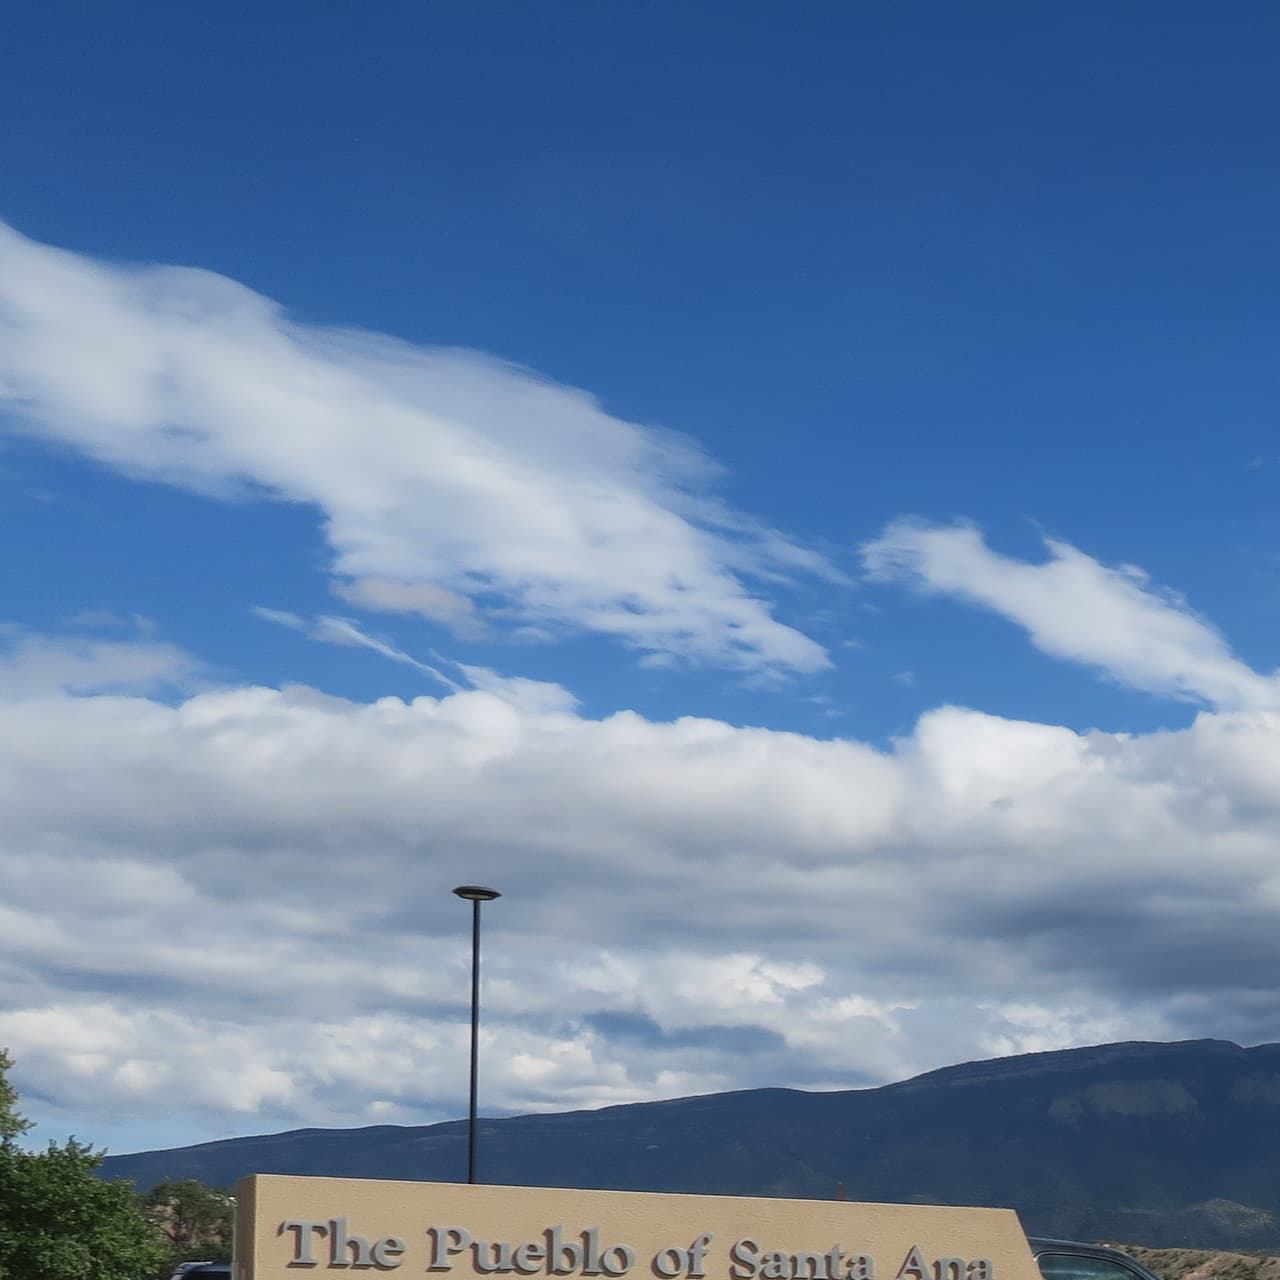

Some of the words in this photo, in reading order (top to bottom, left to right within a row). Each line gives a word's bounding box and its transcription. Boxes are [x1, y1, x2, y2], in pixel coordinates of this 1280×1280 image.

[277, 1217, 406, 1269] The
[426, 1225, 636, 1277] Pueblo
[651, 1232, 713, 1280] of
